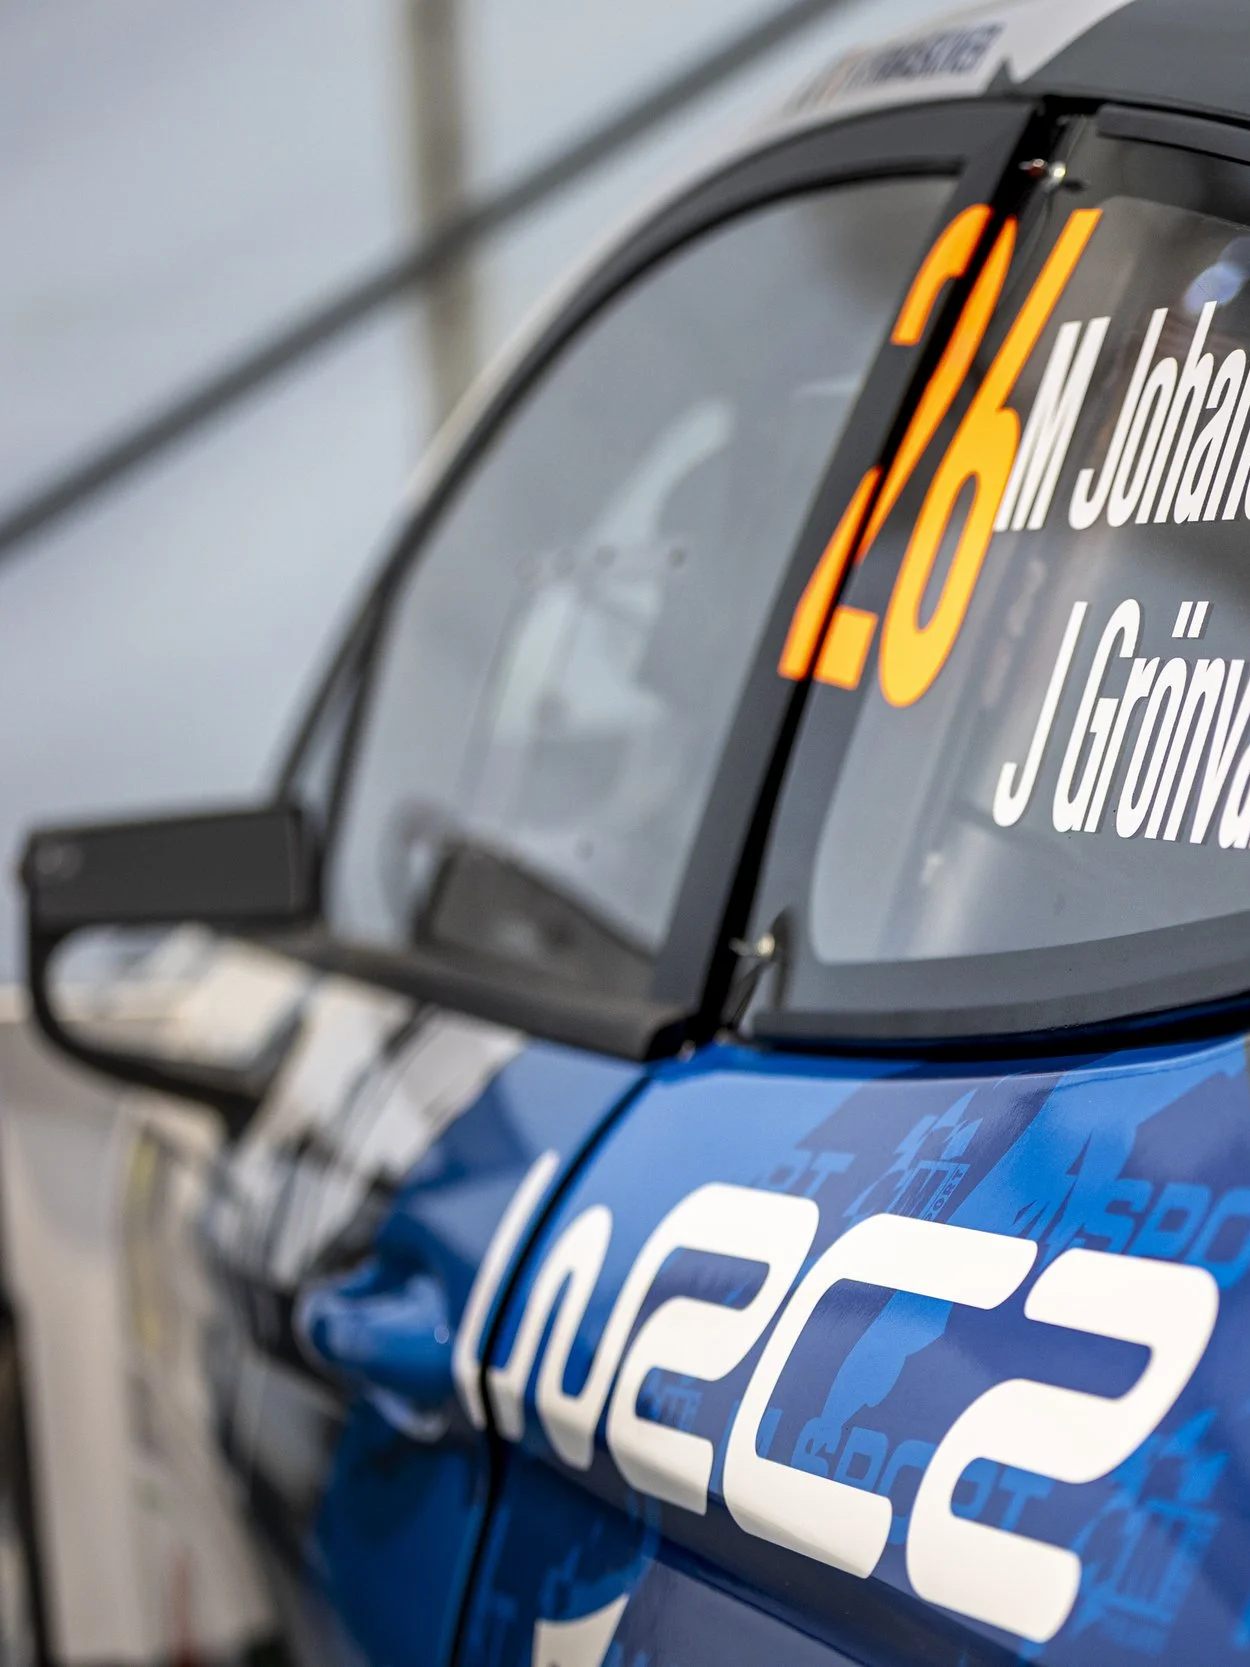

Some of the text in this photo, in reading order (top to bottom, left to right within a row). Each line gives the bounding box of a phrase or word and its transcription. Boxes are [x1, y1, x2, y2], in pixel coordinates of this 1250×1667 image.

[778, 203, 1104, 708] 26
[993, 316, 1110, 531] M
[993, 601, 1089, 827] J
[452, 1150, 1219, 1644] WRC2
